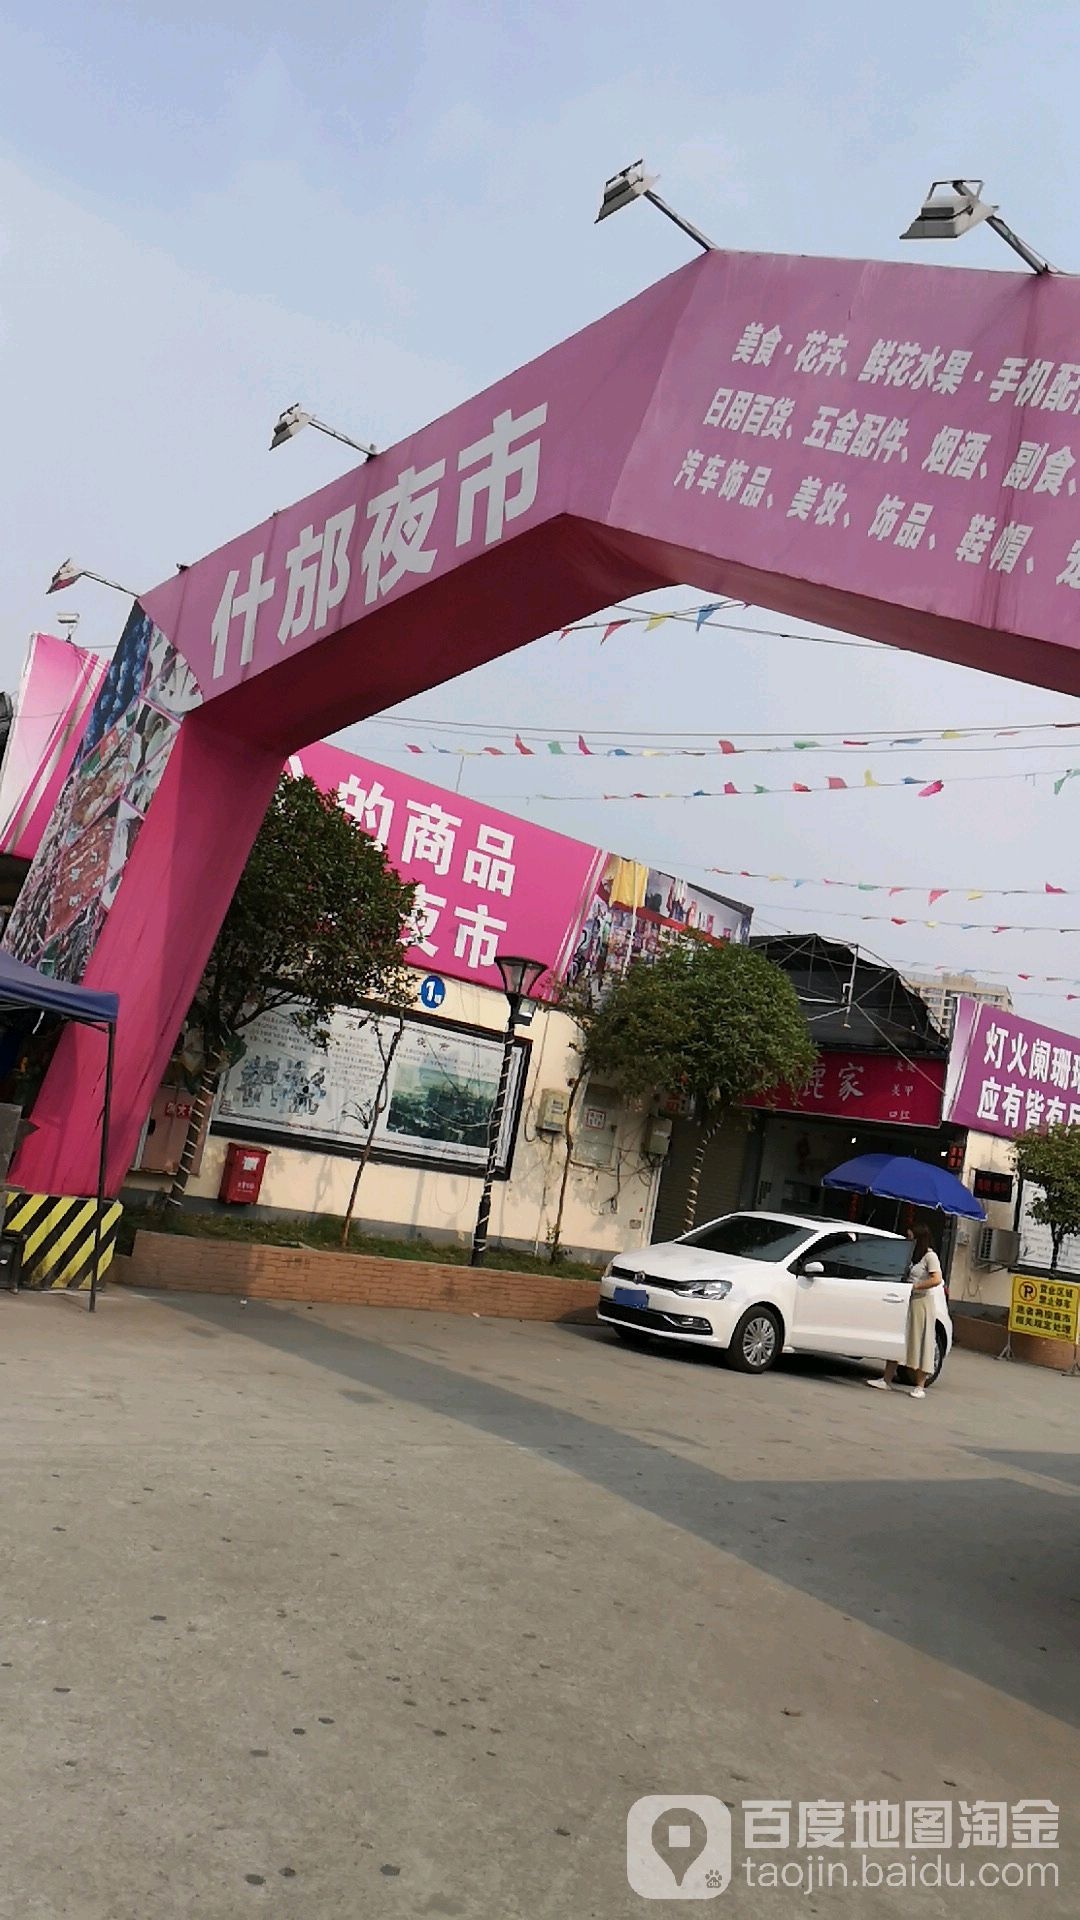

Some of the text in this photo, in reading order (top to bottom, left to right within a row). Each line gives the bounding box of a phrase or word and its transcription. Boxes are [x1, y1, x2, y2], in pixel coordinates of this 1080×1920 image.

[731, 320, 1080, 415] 美食·花卉、鲜花水果·手机配
[210, 401, 549, 680] 什邡夜市
[289, 756, 516, 897] 的商品
